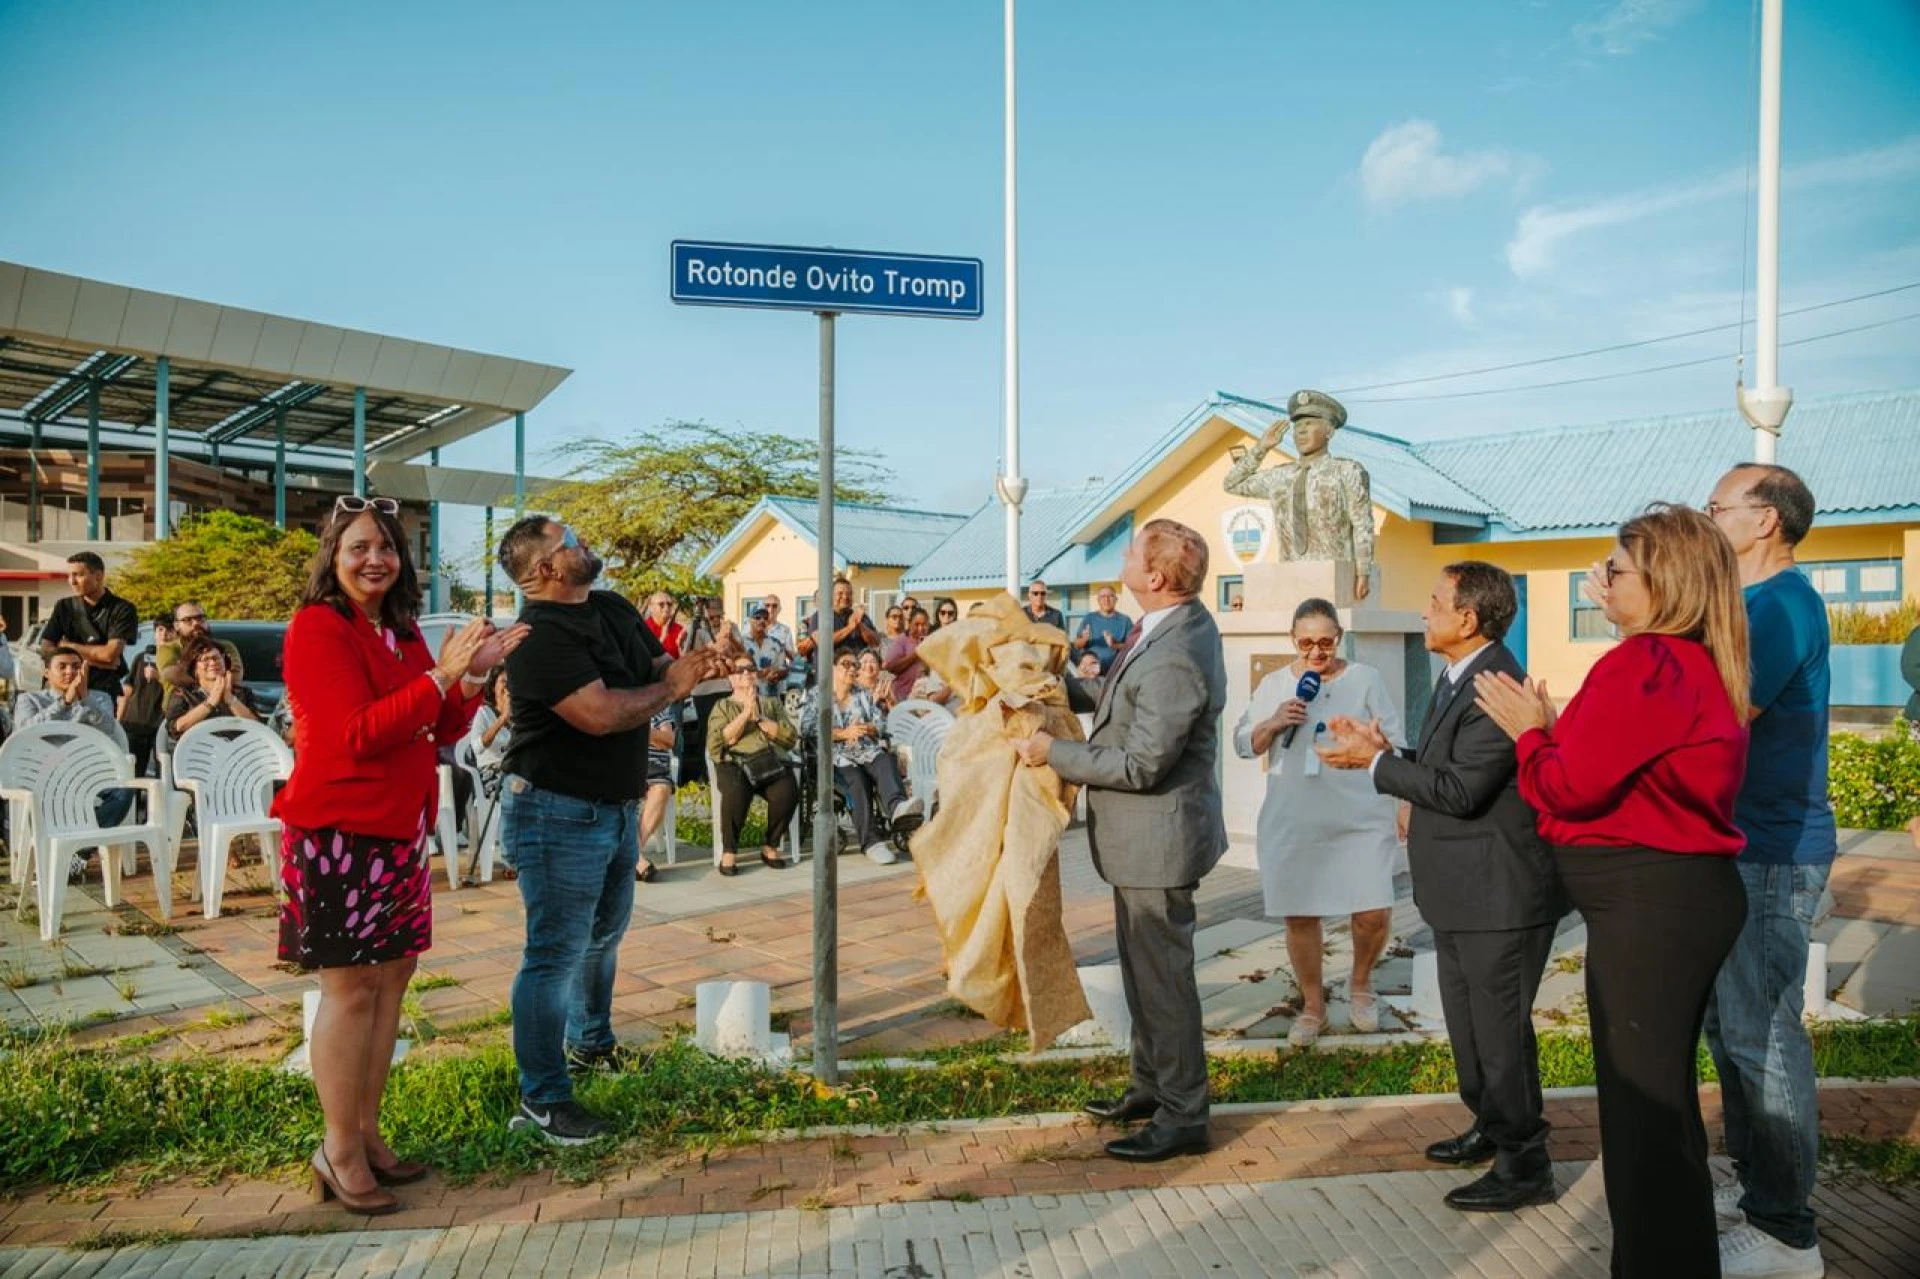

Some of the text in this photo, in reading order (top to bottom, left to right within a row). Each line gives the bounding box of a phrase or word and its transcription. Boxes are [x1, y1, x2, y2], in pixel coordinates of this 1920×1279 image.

[687, 258, 965, 304] Rotonde Ovito Tromp
